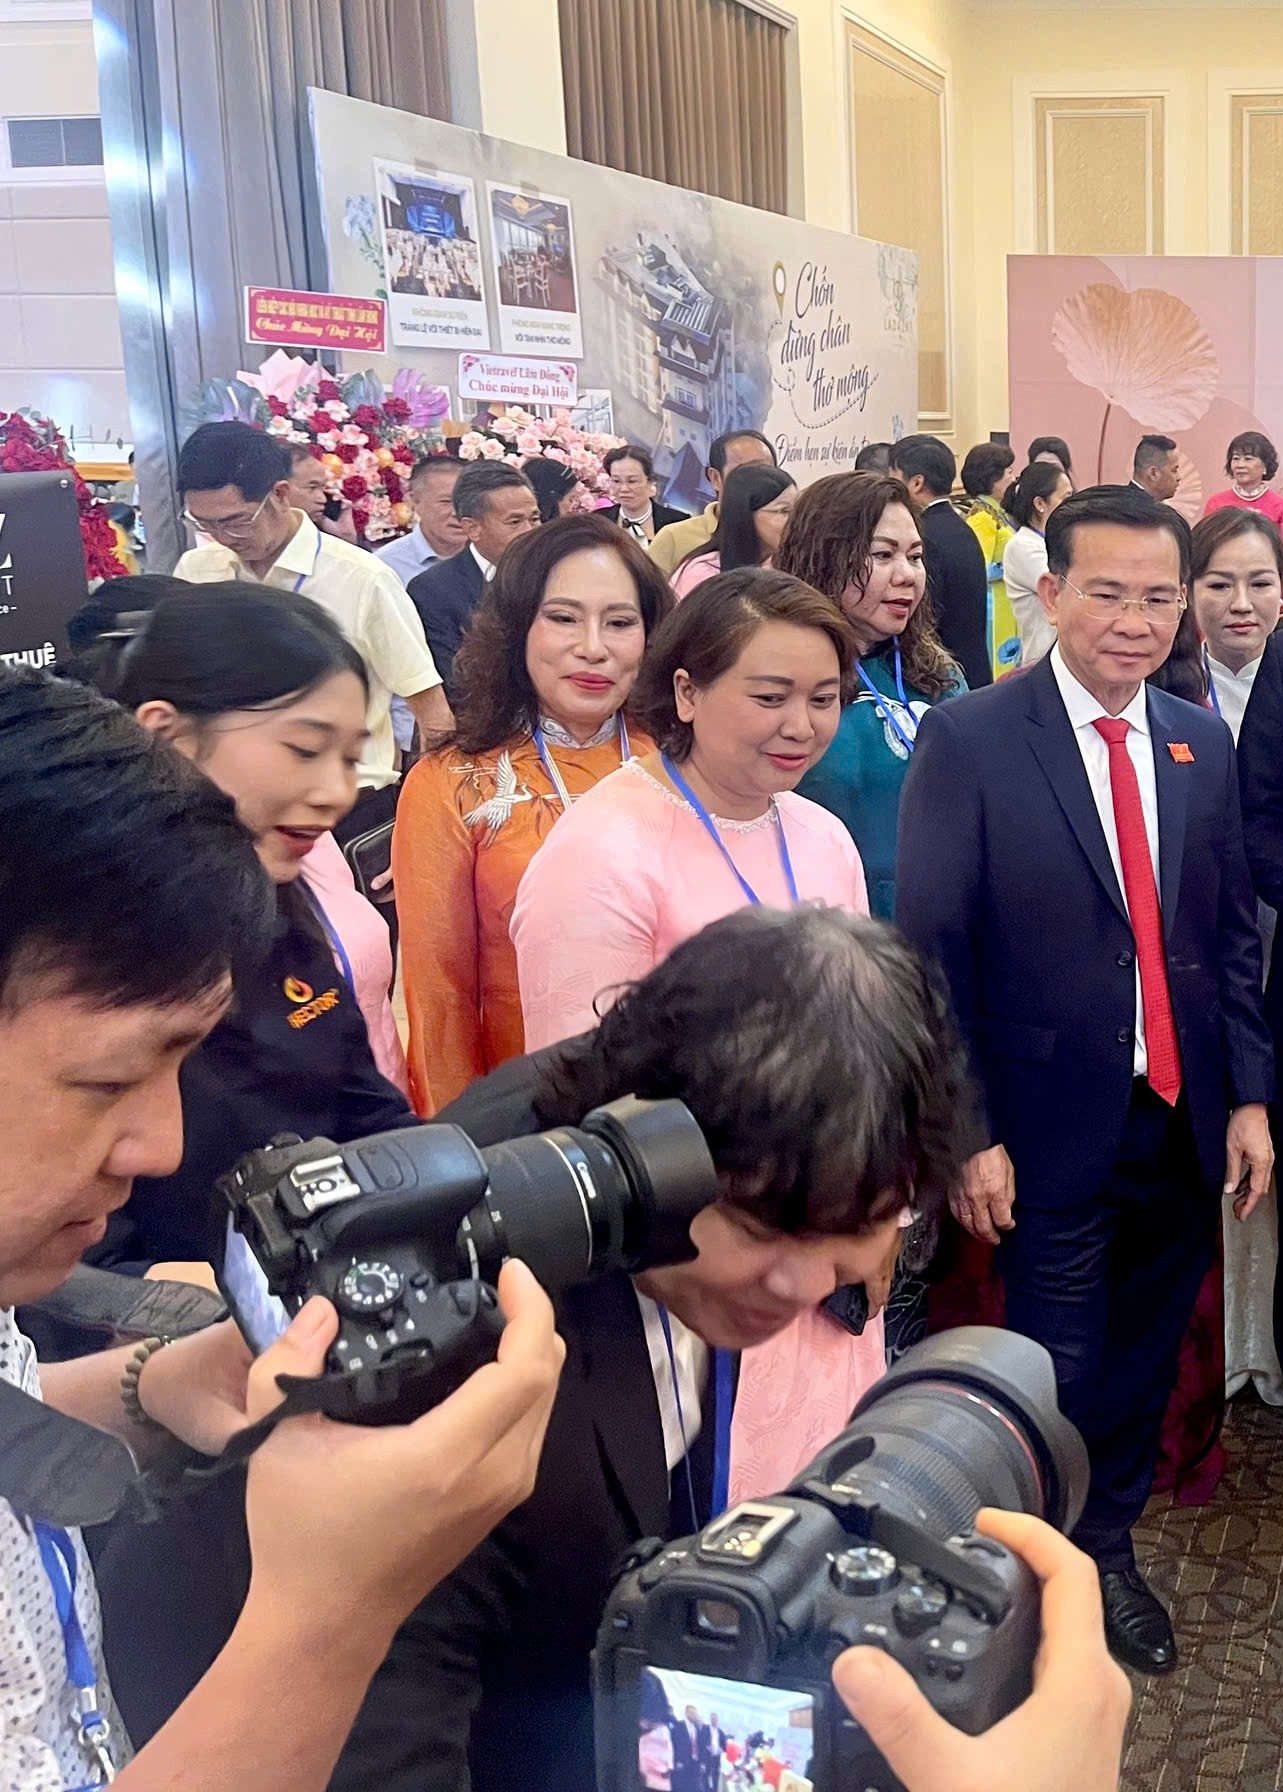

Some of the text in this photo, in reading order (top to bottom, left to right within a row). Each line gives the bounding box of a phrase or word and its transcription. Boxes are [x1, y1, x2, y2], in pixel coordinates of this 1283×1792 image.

[795, 262, 834, 318] Chốn
[820, 309, 851, 352] chân
[469, 379, 569, 400] Chúc mừng Đại Hội
[479, 363, 518, 379] Vietravel
[519, 367, 538, 379] Lâm
[813, 364, 869, 412] thơ mộng
